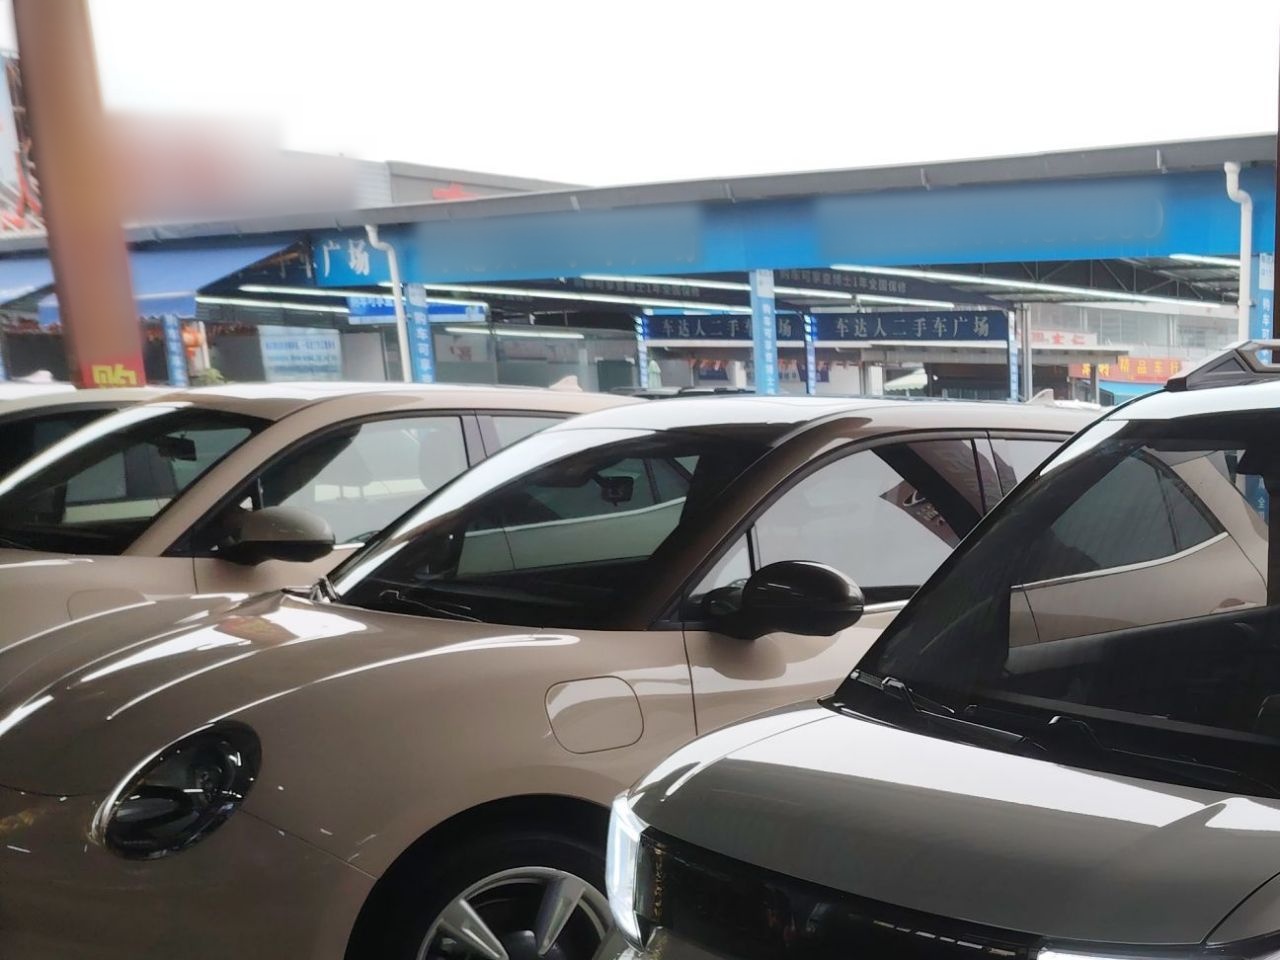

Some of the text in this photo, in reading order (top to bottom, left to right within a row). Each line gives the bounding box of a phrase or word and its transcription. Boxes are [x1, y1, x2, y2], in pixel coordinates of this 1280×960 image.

[835, 316, 990, 338] 车达人二手车广场
